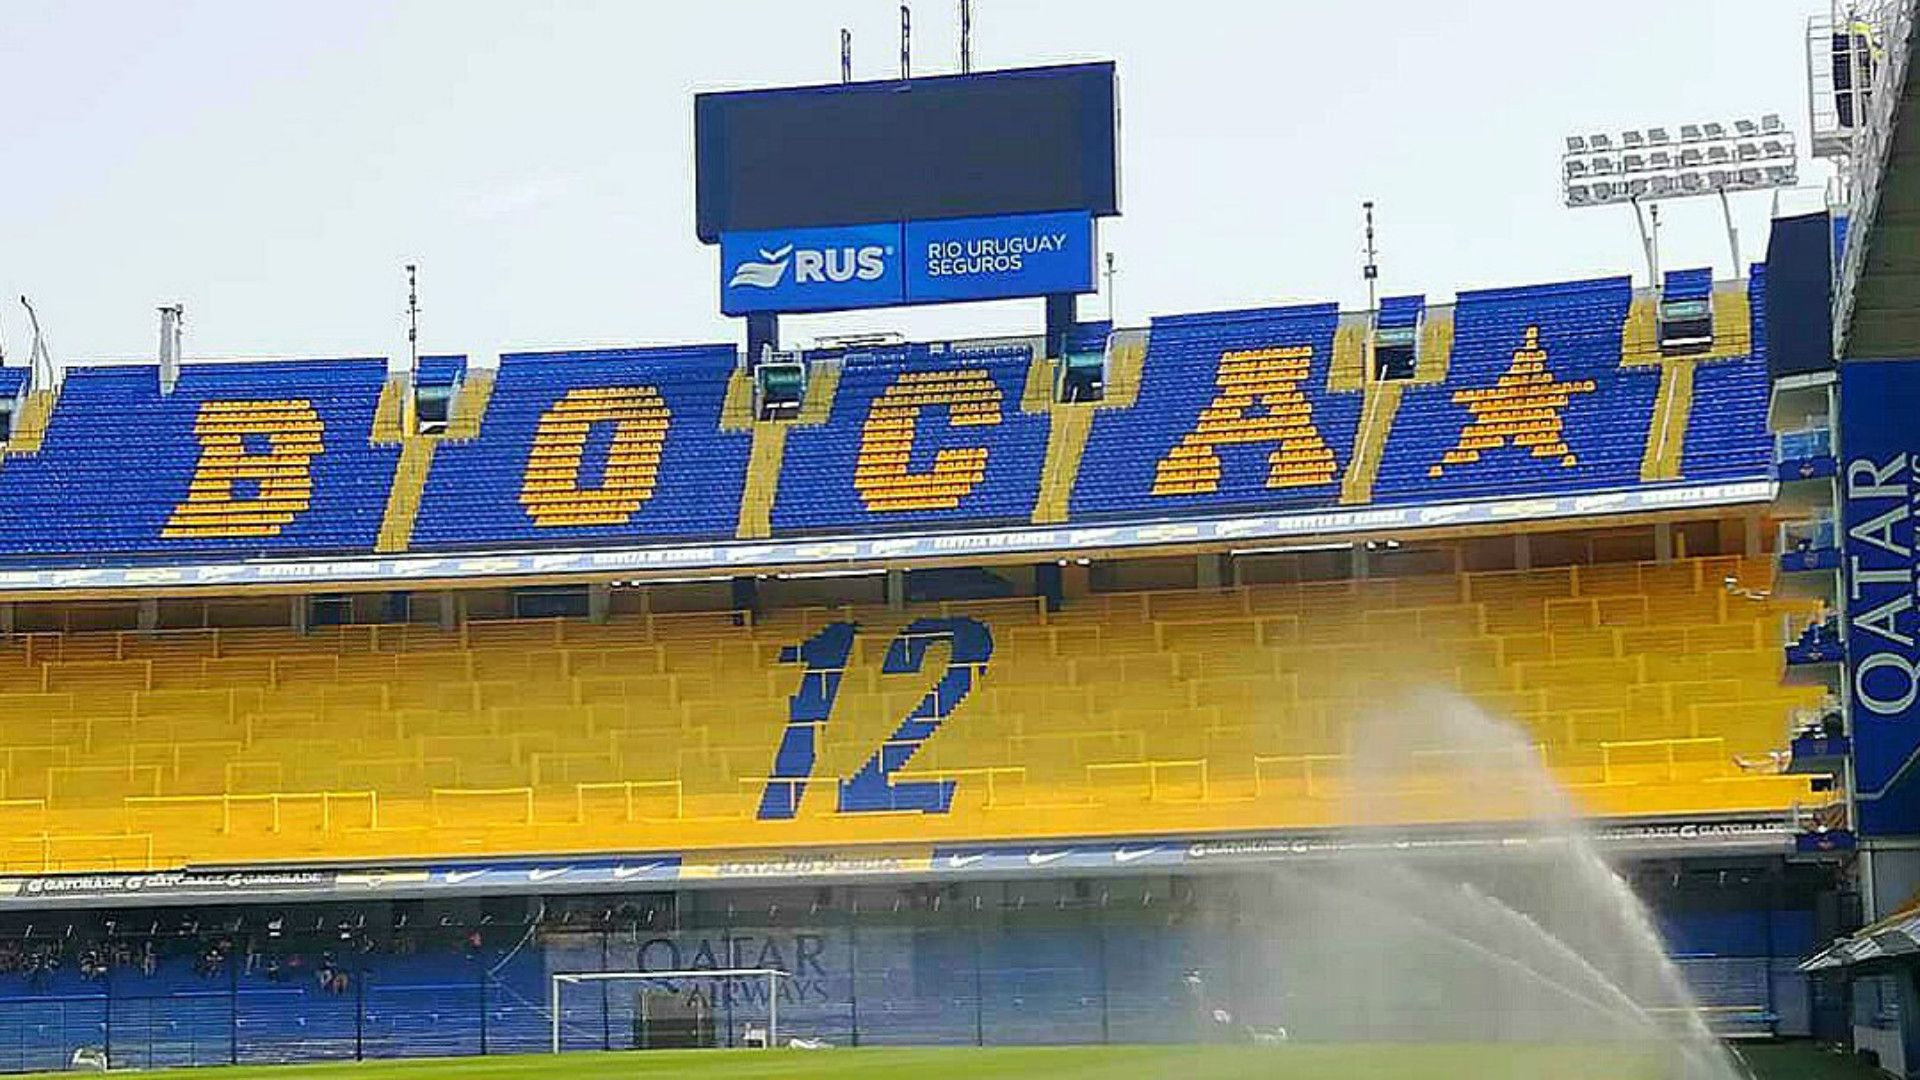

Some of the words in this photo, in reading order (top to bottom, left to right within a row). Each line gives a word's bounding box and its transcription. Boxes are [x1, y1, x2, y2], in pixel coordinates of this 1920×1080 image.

[928, 240, 961, 259] RIO
[967, 233, 1068, 258] URUGUAY
[795, 245, 886, 283] RUS
[928, 254, 1023, 277] SEGUROS
[1848, 452, 1920, 715] QATAR
[756, 617, 994, 820] 12
[45, 877, 124, 891] GATORADE
[638, 936, 828, 992] QATAR
[686, 979, 829, 1009] AIRWAYS
